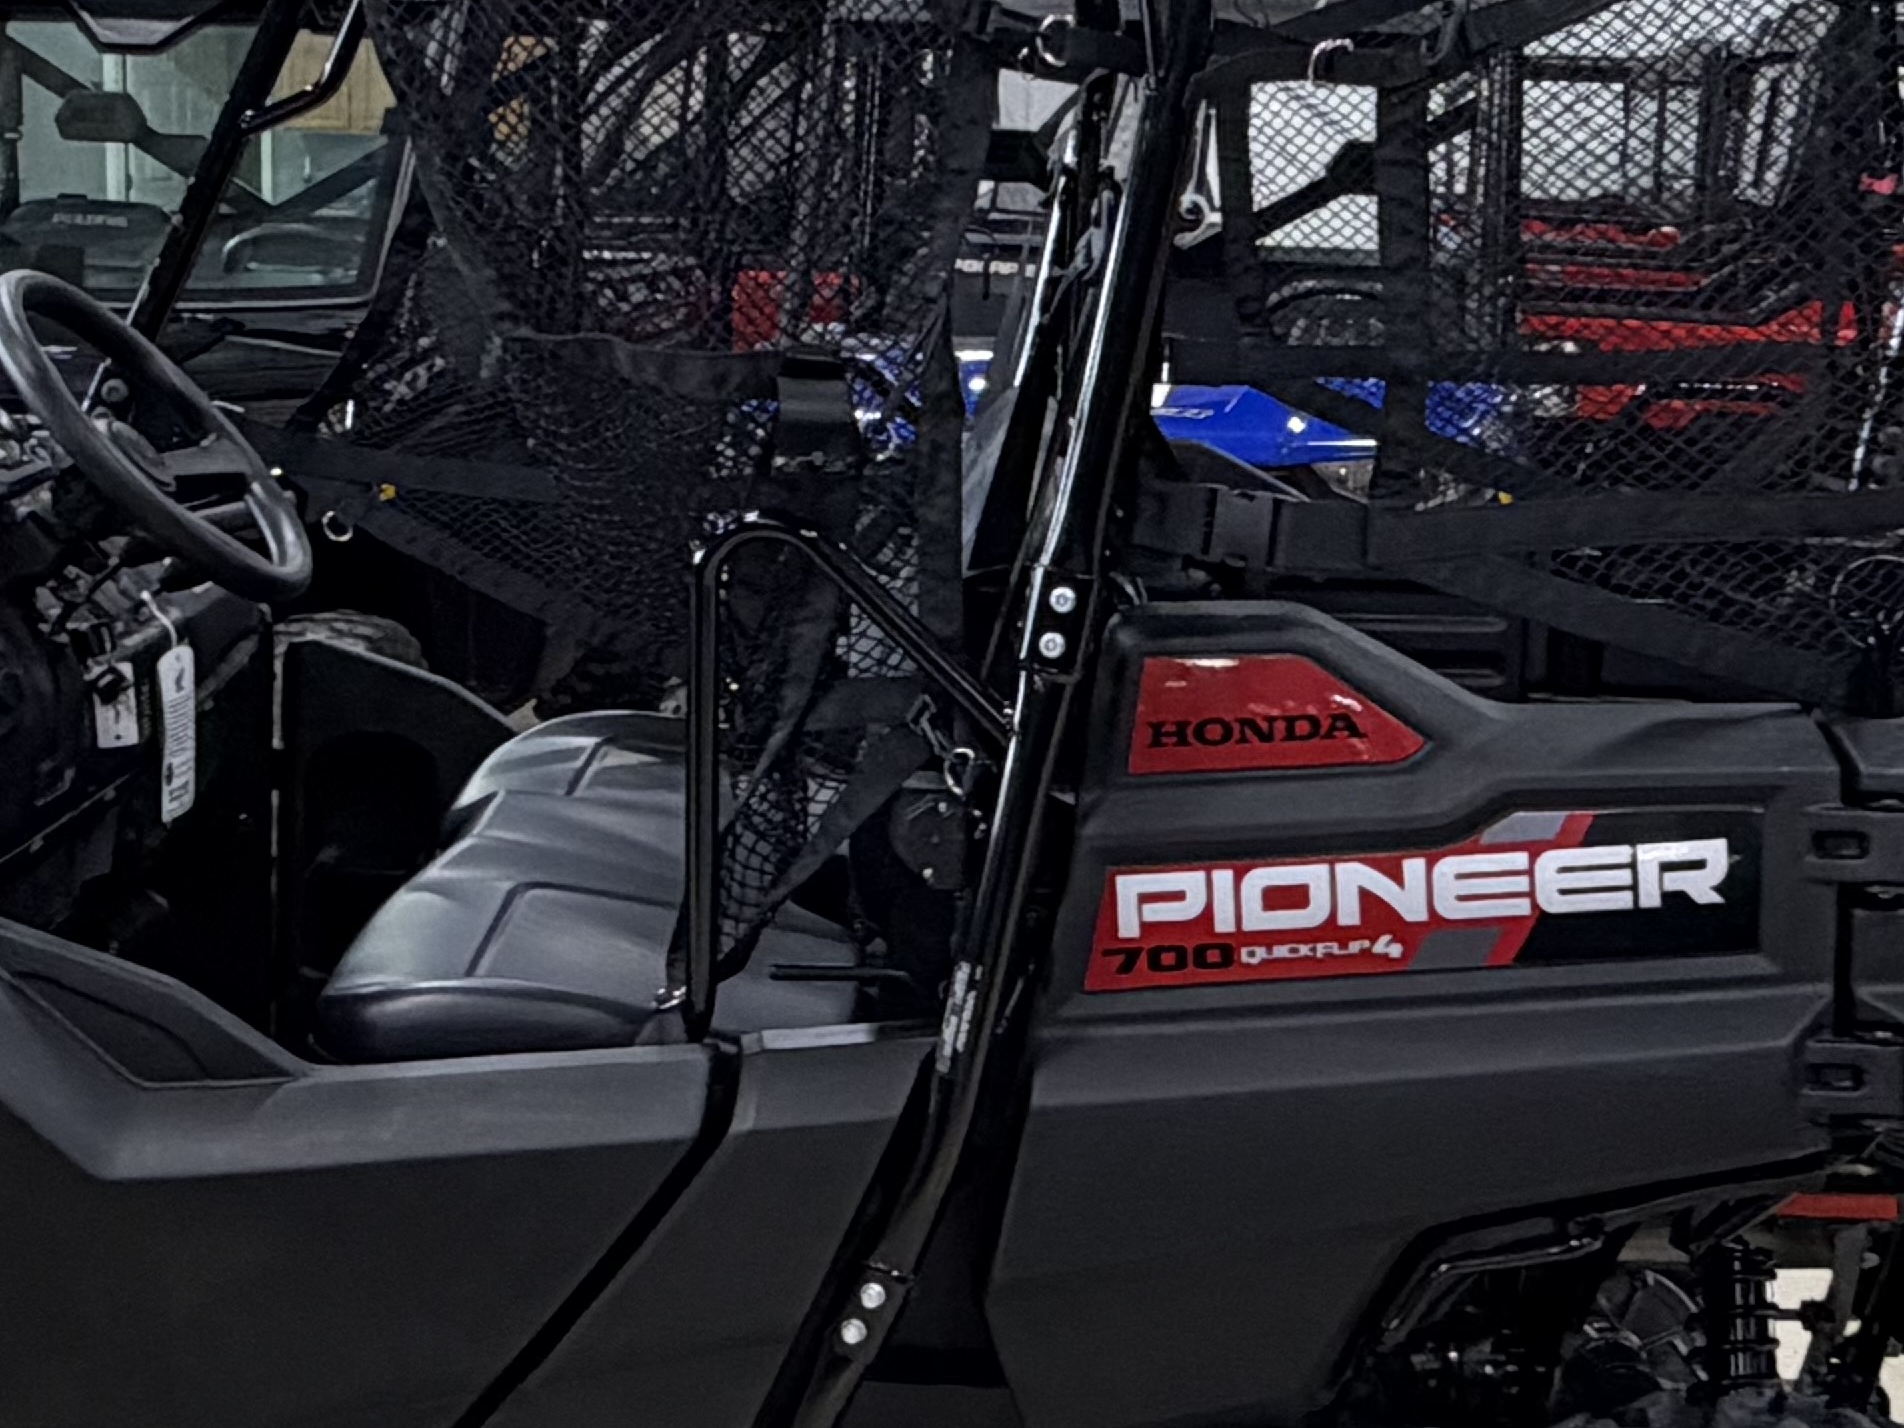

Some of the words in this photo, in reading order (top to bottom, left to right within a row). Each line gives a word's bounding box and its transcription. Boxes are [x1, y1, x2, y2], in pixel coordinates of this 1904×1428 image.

[1147, 712, 1368, 748] HONDA
[1115, 838, 1729, 939] PIONEER
[1101, 942, 1235, 975] 700
